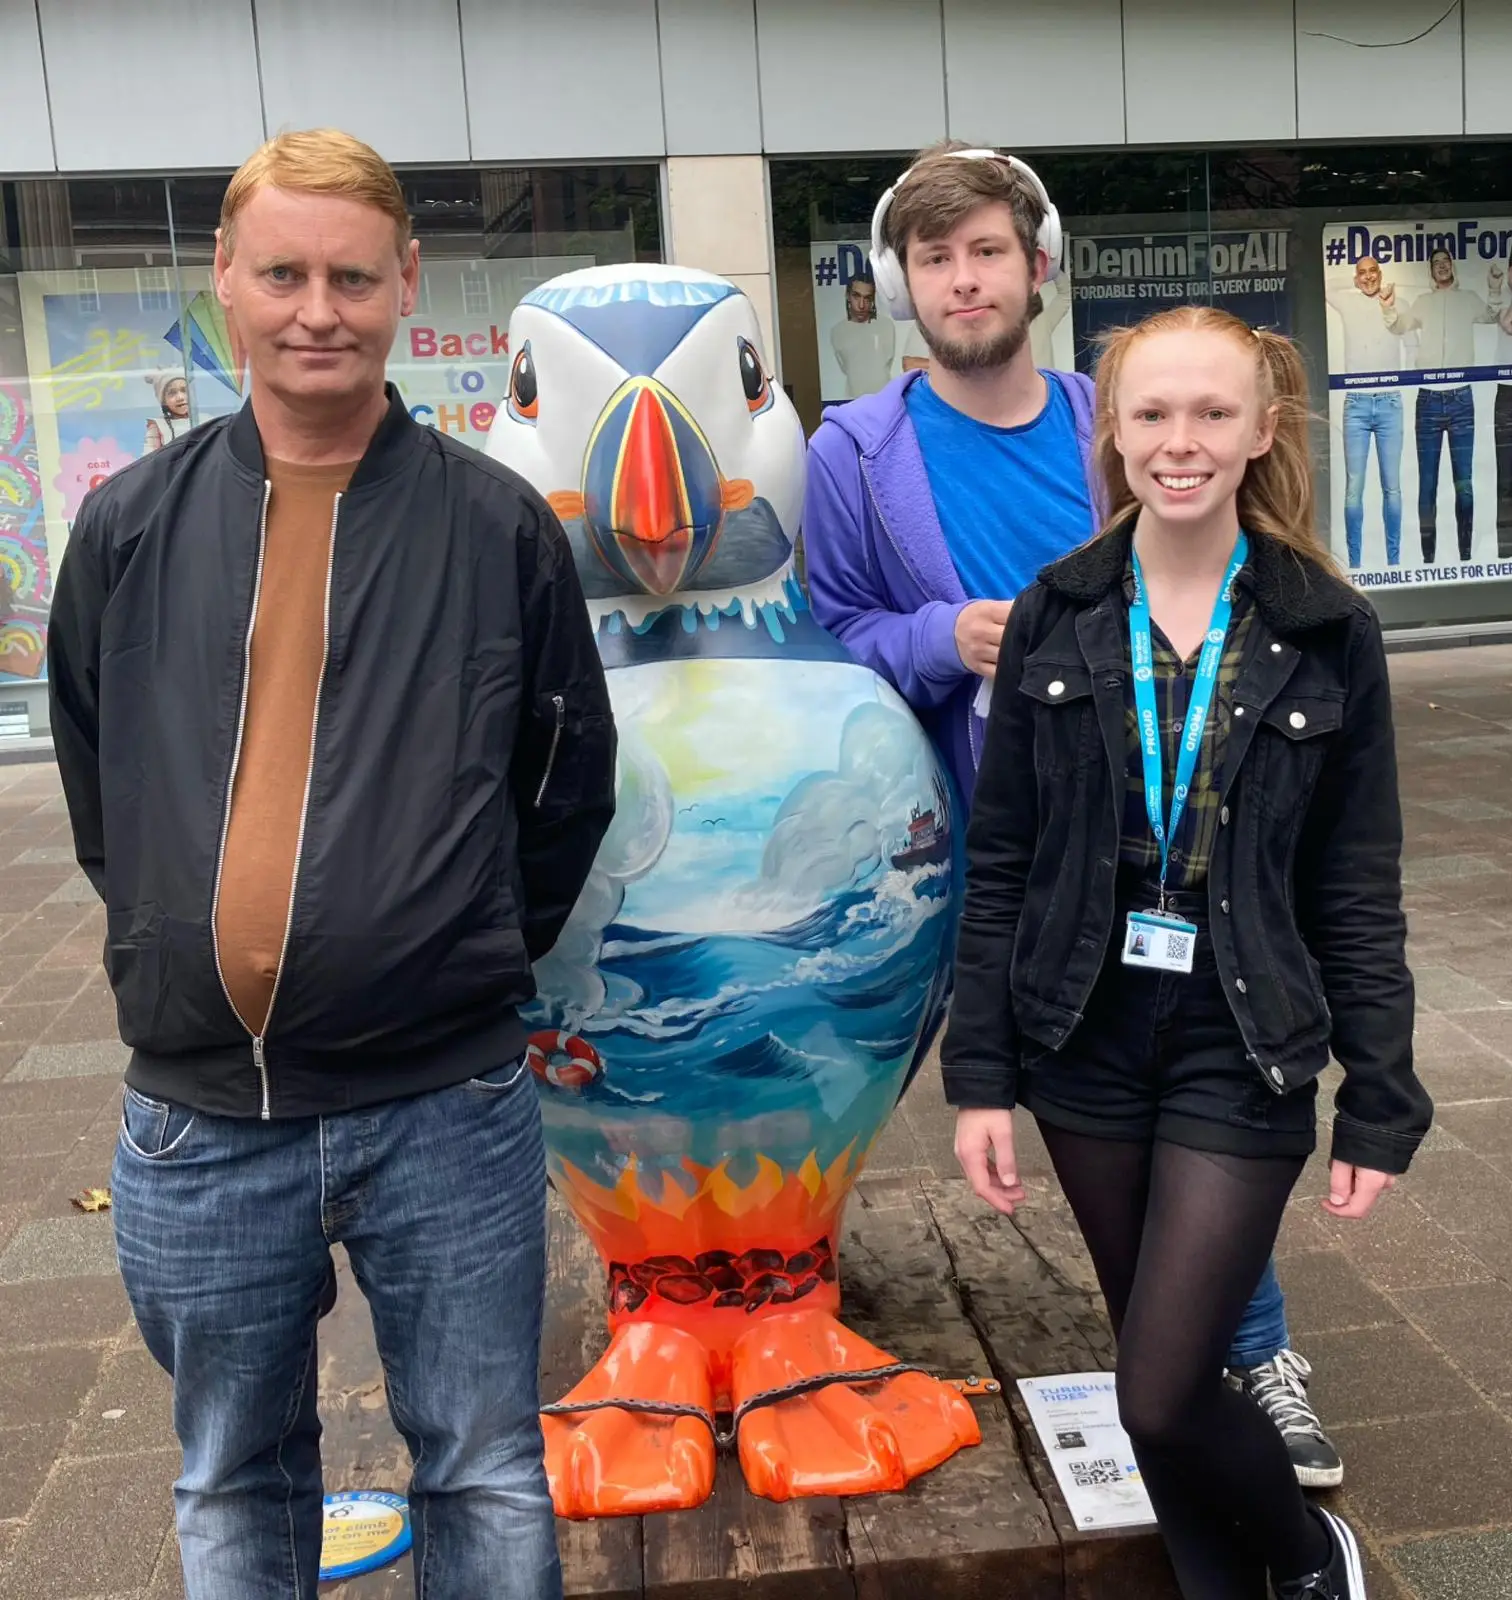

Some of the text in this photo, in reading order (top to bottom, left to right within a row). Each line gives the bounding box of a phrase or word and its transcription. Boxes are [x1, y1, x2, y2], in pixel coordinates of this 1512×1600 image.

[1071, 231, 1288, 279] DenimForAll
[1072, 277, 1286, 299] FORDABLE STYLES FOR EVERY BODY
[410, 325, 509, 357] Back
[444, 365, 485, 394] to
[87, 460, 111, 469] coat
[1415, 566, 1458, 582] STYLES
[1461, 564, 1484, 579] FOR
[1142, 709, 1156, 755] PROUD
[1186, 706, 1204, 752] PROUD
[1037, 1383, 1116, 1396] TURBULE
[1040, 1391, 1088, 1403] TIDES
[346, 1520, 388, 1531] climb
